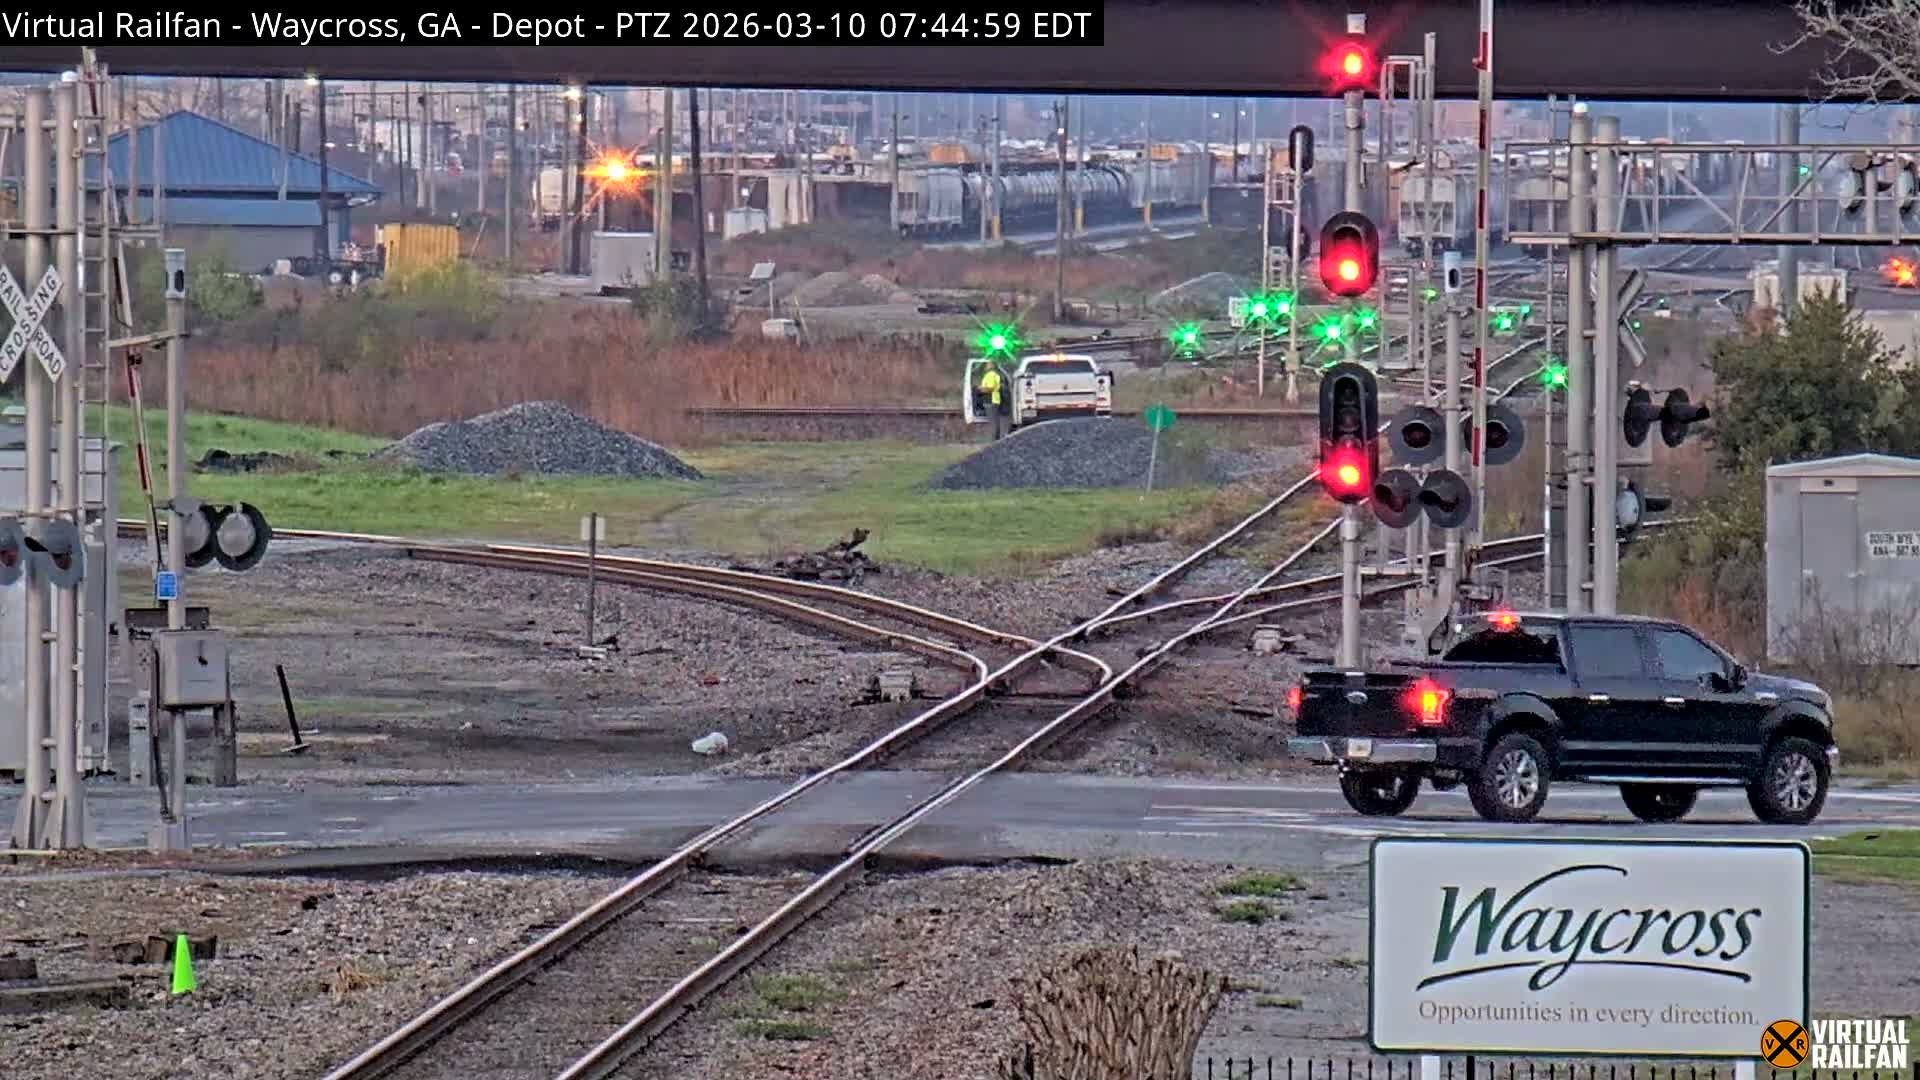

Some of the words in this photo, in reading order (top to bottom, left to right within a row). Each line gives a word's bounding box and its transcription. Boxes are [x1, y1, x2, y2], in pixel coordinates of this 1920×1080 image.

[0, 274, 57, 372] CROSSING
[33, 328, 63, 375] ROAD
[1431, 865, 1762, 991] Waycross
[1418, 999, 1562, 1025] Opportunities
[1570, 1001, 1588, 1023] in
[1595, 1007, 1654, 1028] every
[1660, 1003, 1760, 1025] direction.
